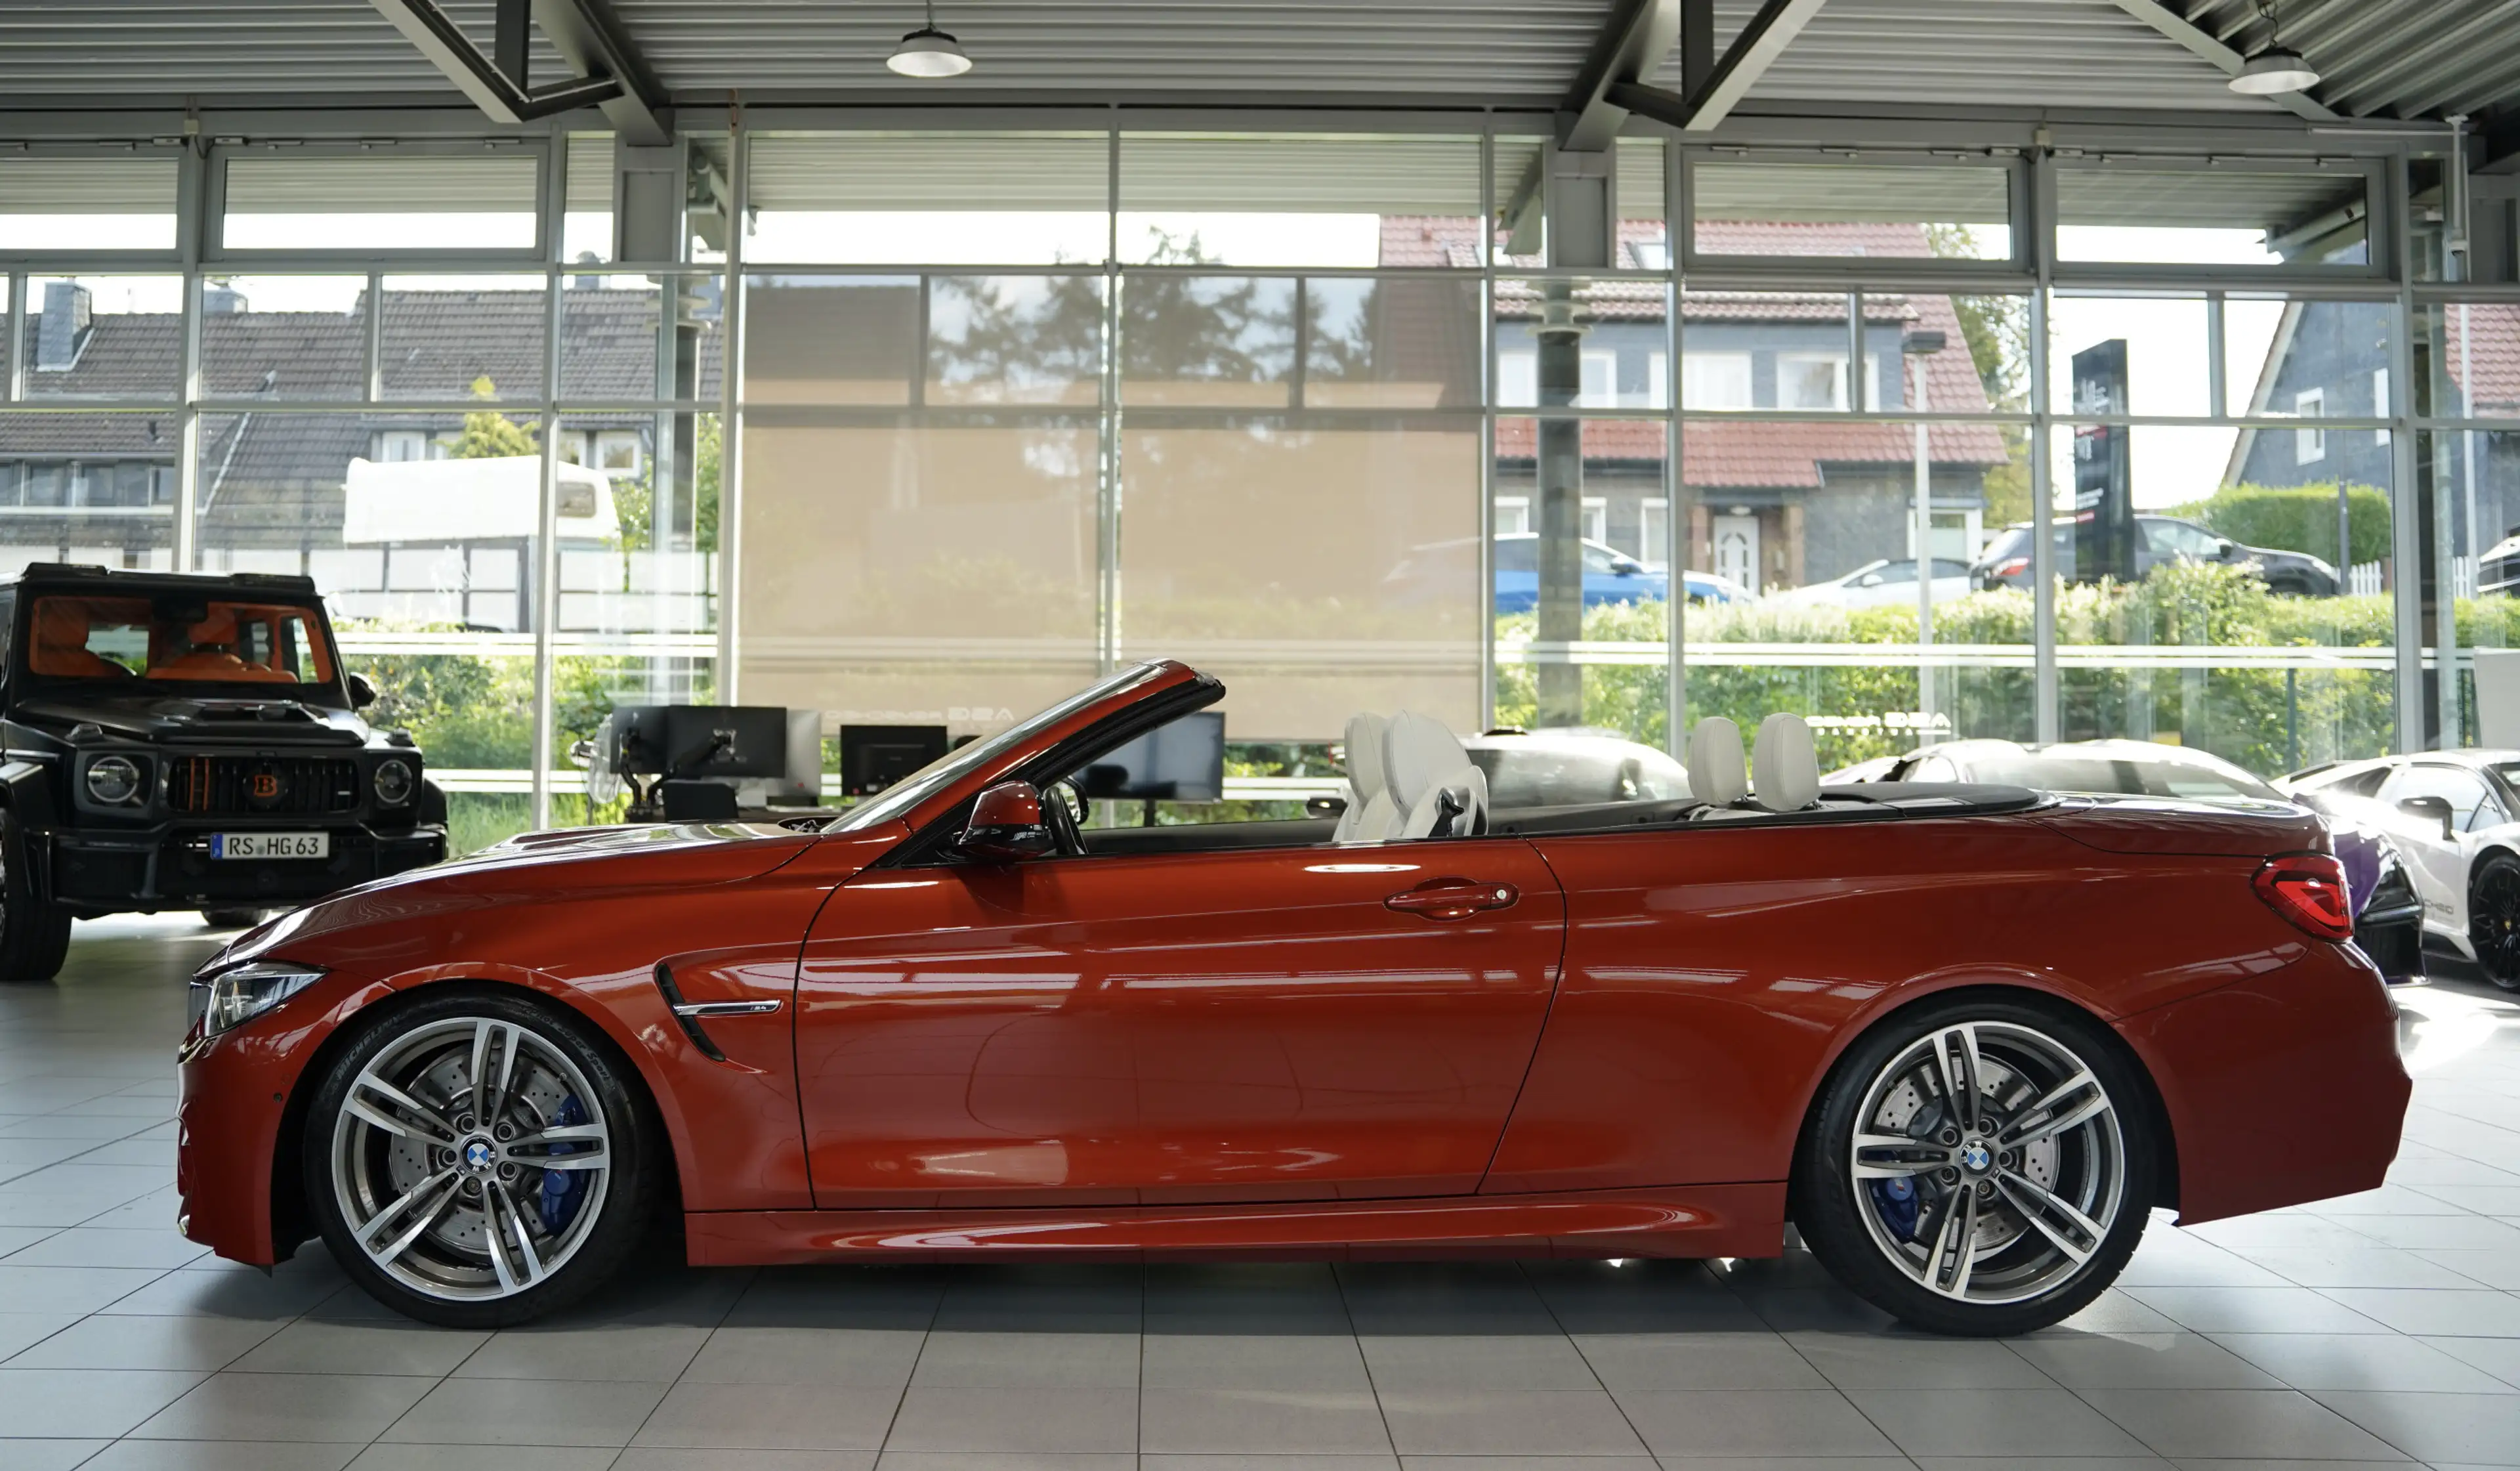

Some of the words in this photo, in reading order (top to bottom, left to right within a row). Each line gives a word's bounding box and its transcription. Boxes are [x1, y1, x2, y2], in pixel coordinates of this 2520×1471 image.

[229, 837, 254, 855] RS
[266, 837, 291, 855] HG
[296, 837, 319, 855] 63
[335, 1015, 400, 1081] MICHELIN
[586, 1051, 611, 1082] Sport
[472, 1151, 495, 1172] BMW
[1960, 1141, 1983, 1164] BMW
